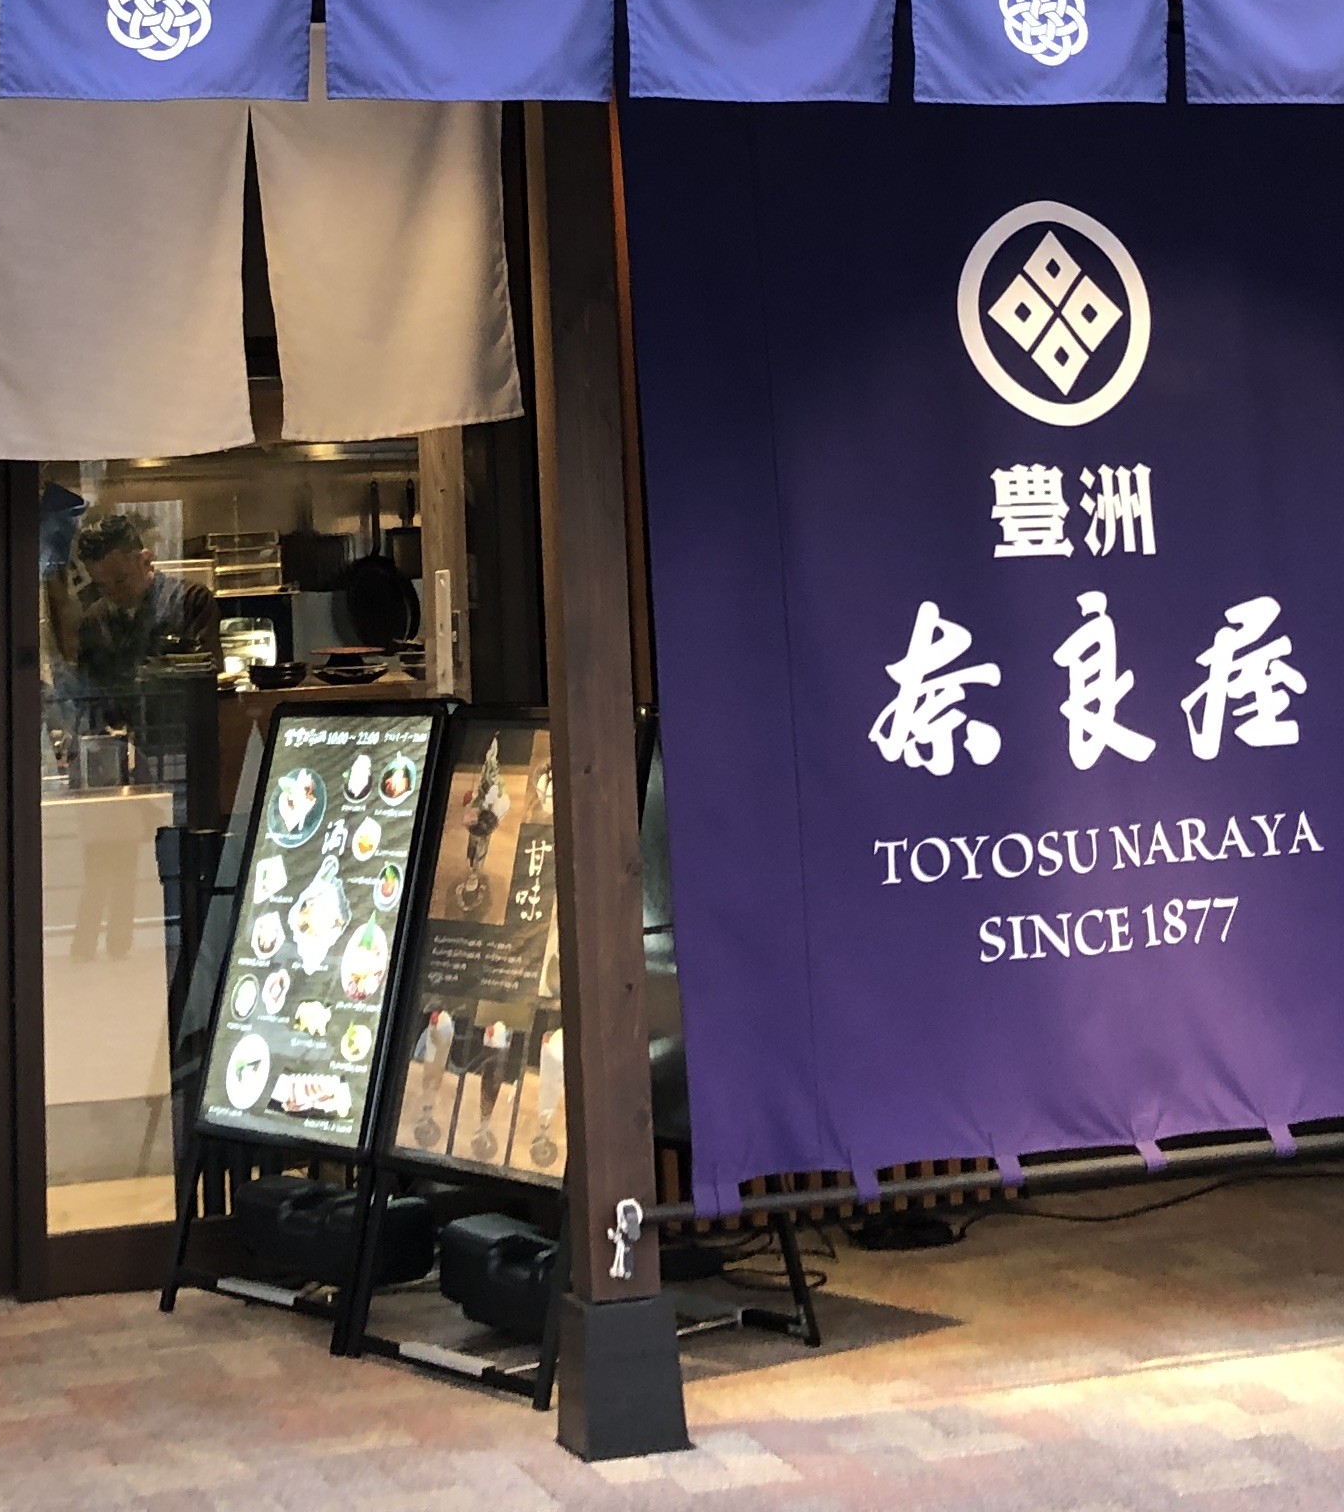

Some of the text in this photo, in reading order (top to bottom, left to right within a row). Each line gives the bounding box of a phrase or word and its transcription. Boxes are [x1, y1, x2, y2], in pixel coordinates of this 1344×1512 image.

[990, 462, 1157, 558] 豊洲
[867, 590, 1308, 776] 奈良屋
[515, 839, 553, 922] 甘味
[873, 810, 1324, 885] TOYOSU NARAYA
[978, 895, 1239, 963] SINCE 1877
